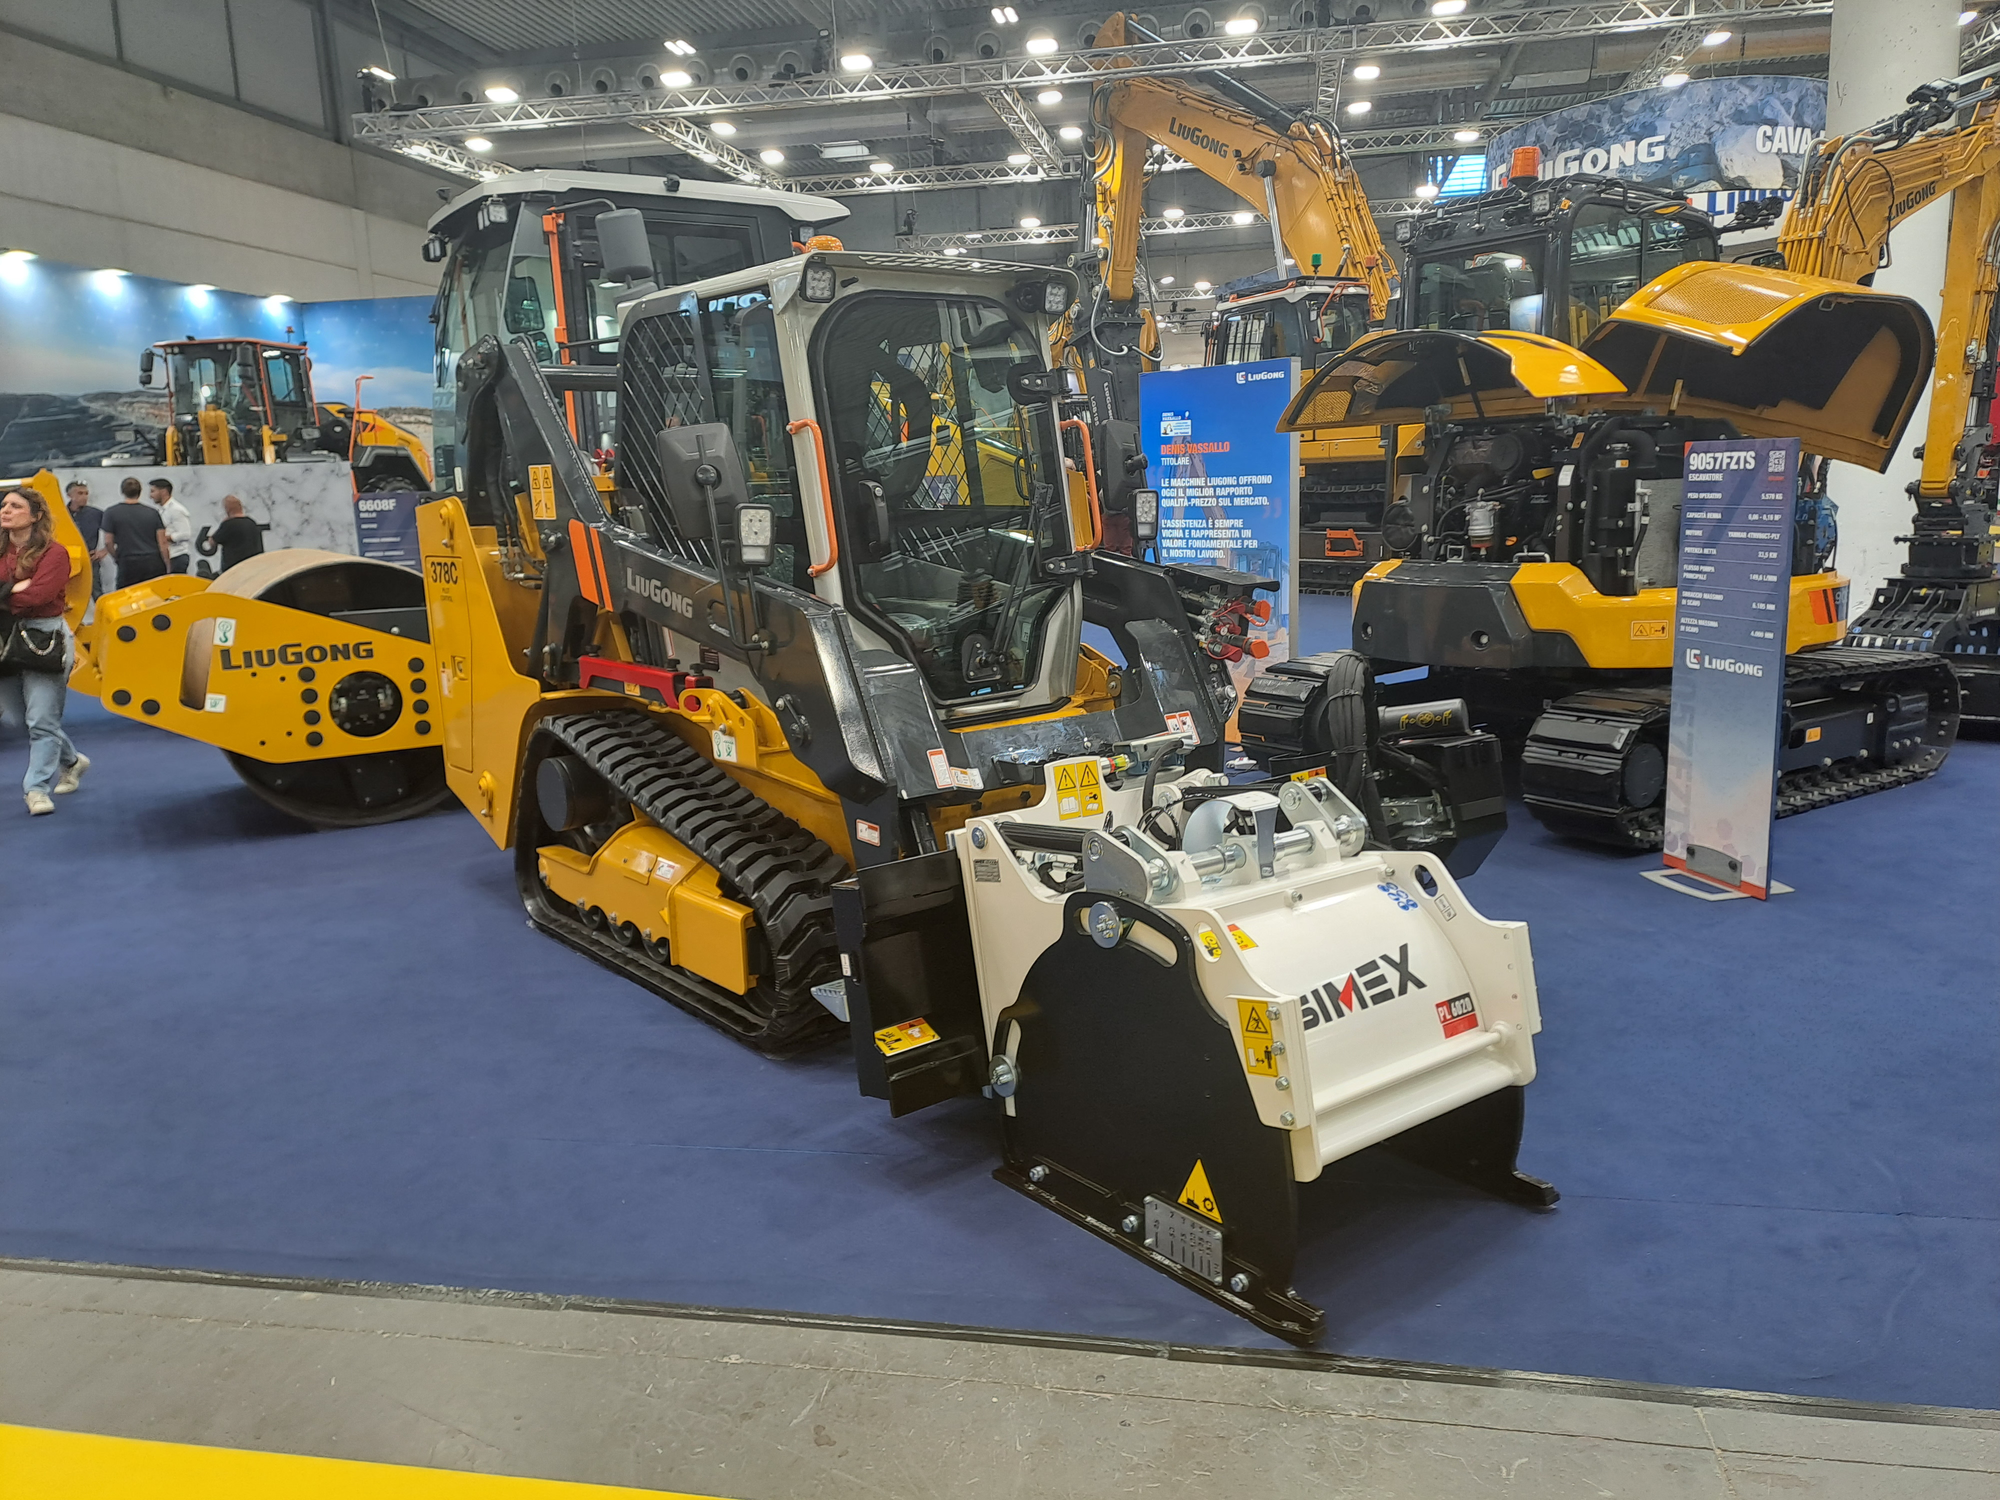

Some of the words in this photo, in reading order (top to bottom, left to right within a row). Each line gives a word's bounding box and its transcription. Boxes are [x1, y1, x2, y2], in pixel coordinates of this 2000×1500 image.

[1161, 444, 1186, 455] DENIS
[1187, 441, 1230, 454] VASSALLO
[1161, 457, 1190, 466] TITOLARE
[1689, 450, 1756, 471] 9057FZTS
[1161, 478, 1170, 487] LE
[1171, 477, 1206, 487] MACCHINE
[1207, 476, 1237, 486] LIUGONG
[1239, 475, 1273, 485] OFFRONO
[1687, 473, 1724, 482] ESCAVATORE
[1161, 488, 1177, 497] OGGI
[1178, 488, 1185, 497] IL
[1186, 487, 1214, 497] MIGLIOR
[1216, 486, 1253, 496] RAPPORTO
[358, 499, 396, 512] 6608F
[1161, 495, 1217, 507] QUALITÀ-PREZZO
[1218, 497, 1232, 506] SUL
[1233, 496, 1270, 506] MERCATO.
[1161, 519, 1207, 528] L'ASSISTENZA
[1208, 517, 1213, 528] È
[1214, 519, 1244, 528] SEMPRE
[1161, 529, 1184, 538] VICINA
[1185, 529, 1190, 538] E
[1191, 529, 1240, 539] RAPPRESENTA
[1241, 529, 1252, 539] UN
[1161, 539, 1187, 548] VALORE
[1188, 539, 1242, 549] FONDAMENTALE
[1243, 539, 1258, 548] PER
[1162, 549, 1168, 558] IL
[1169, 549, 1196, 558] NOSTRO
[1197, 549, 1226, 559] LAVORO.
[430, 561, 459, 585] 378C
[1299, 942, 1428, 1031] SIMEX
[1437, 1004, 1452, 1022] PL
[1450, 997, 1473, 1018] 6020
